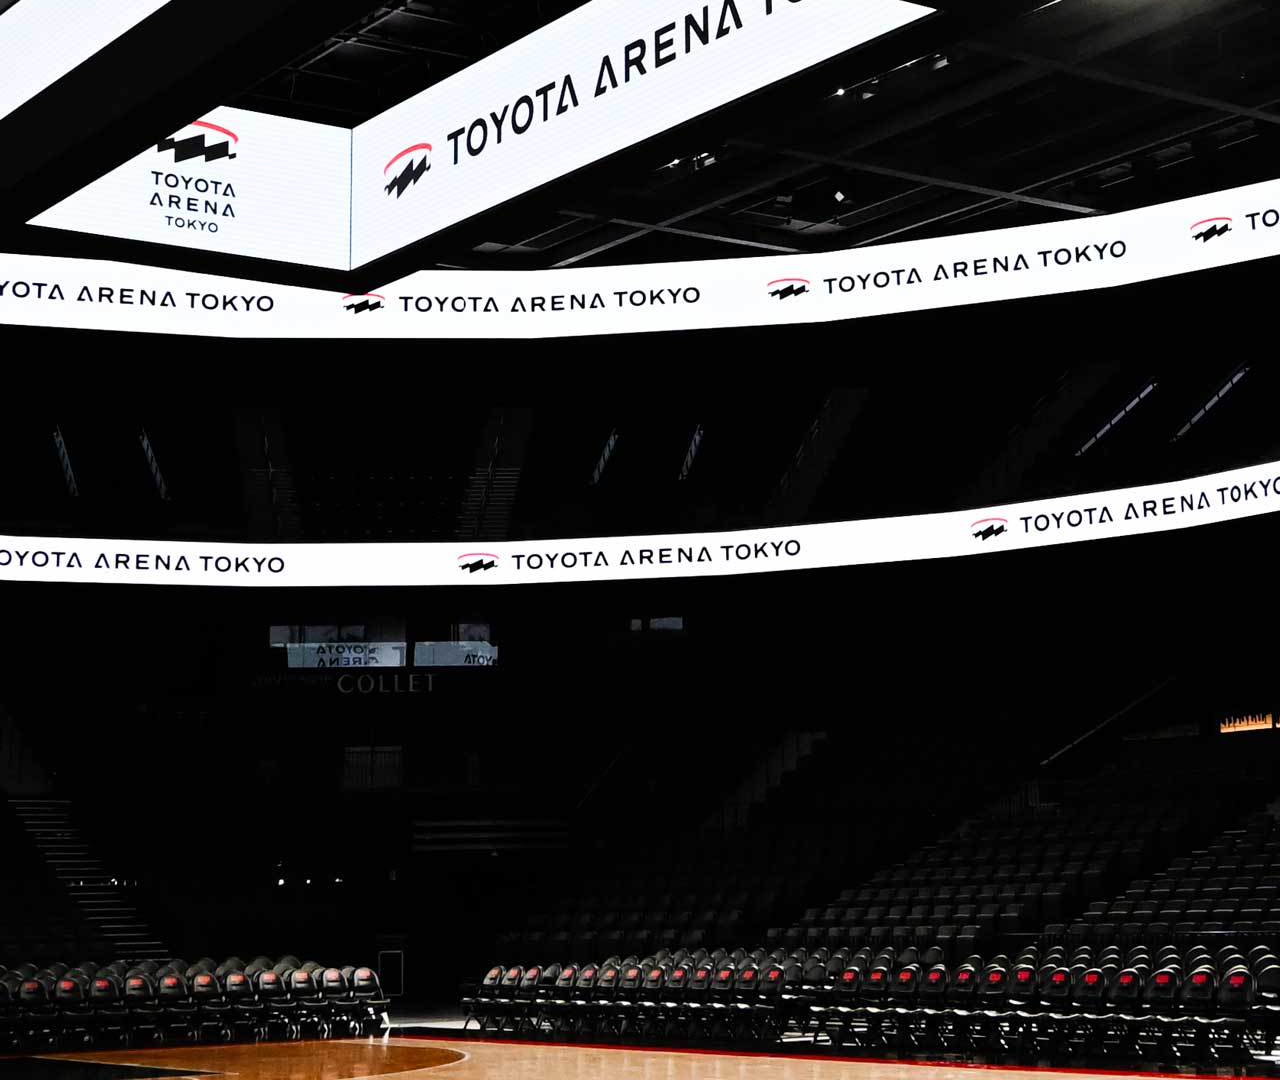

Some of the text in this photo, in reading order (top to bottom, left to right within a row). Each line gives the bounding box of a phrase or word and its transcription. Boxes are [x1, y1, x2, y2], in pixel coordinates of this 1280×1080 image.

[446, 73, 579, 166] TOYOTA
[151, 170, 236, 198] TOYOTA
[149, 192, 236, 218] ARENA
[165, 215, 218, 233] TOKYO
[822, 240, 1127, 295] TOYOTA ARENA TOKYO
[76, 285, 177, 308] ARENA
[185, 292, 274, 312] TOKYO
[398, 286, 701, 313] TOYOTA ARENA TOKYO
[1019, 506, 1114, 533] TOYOTA
[1124, 491, 1211, 521] ARENA
[94, 552, 191, 571] ARENA
[199, 555, 285, 574] TOKYO
[511, 539, 801, 570] TOYOTA ARENA TOKYO
